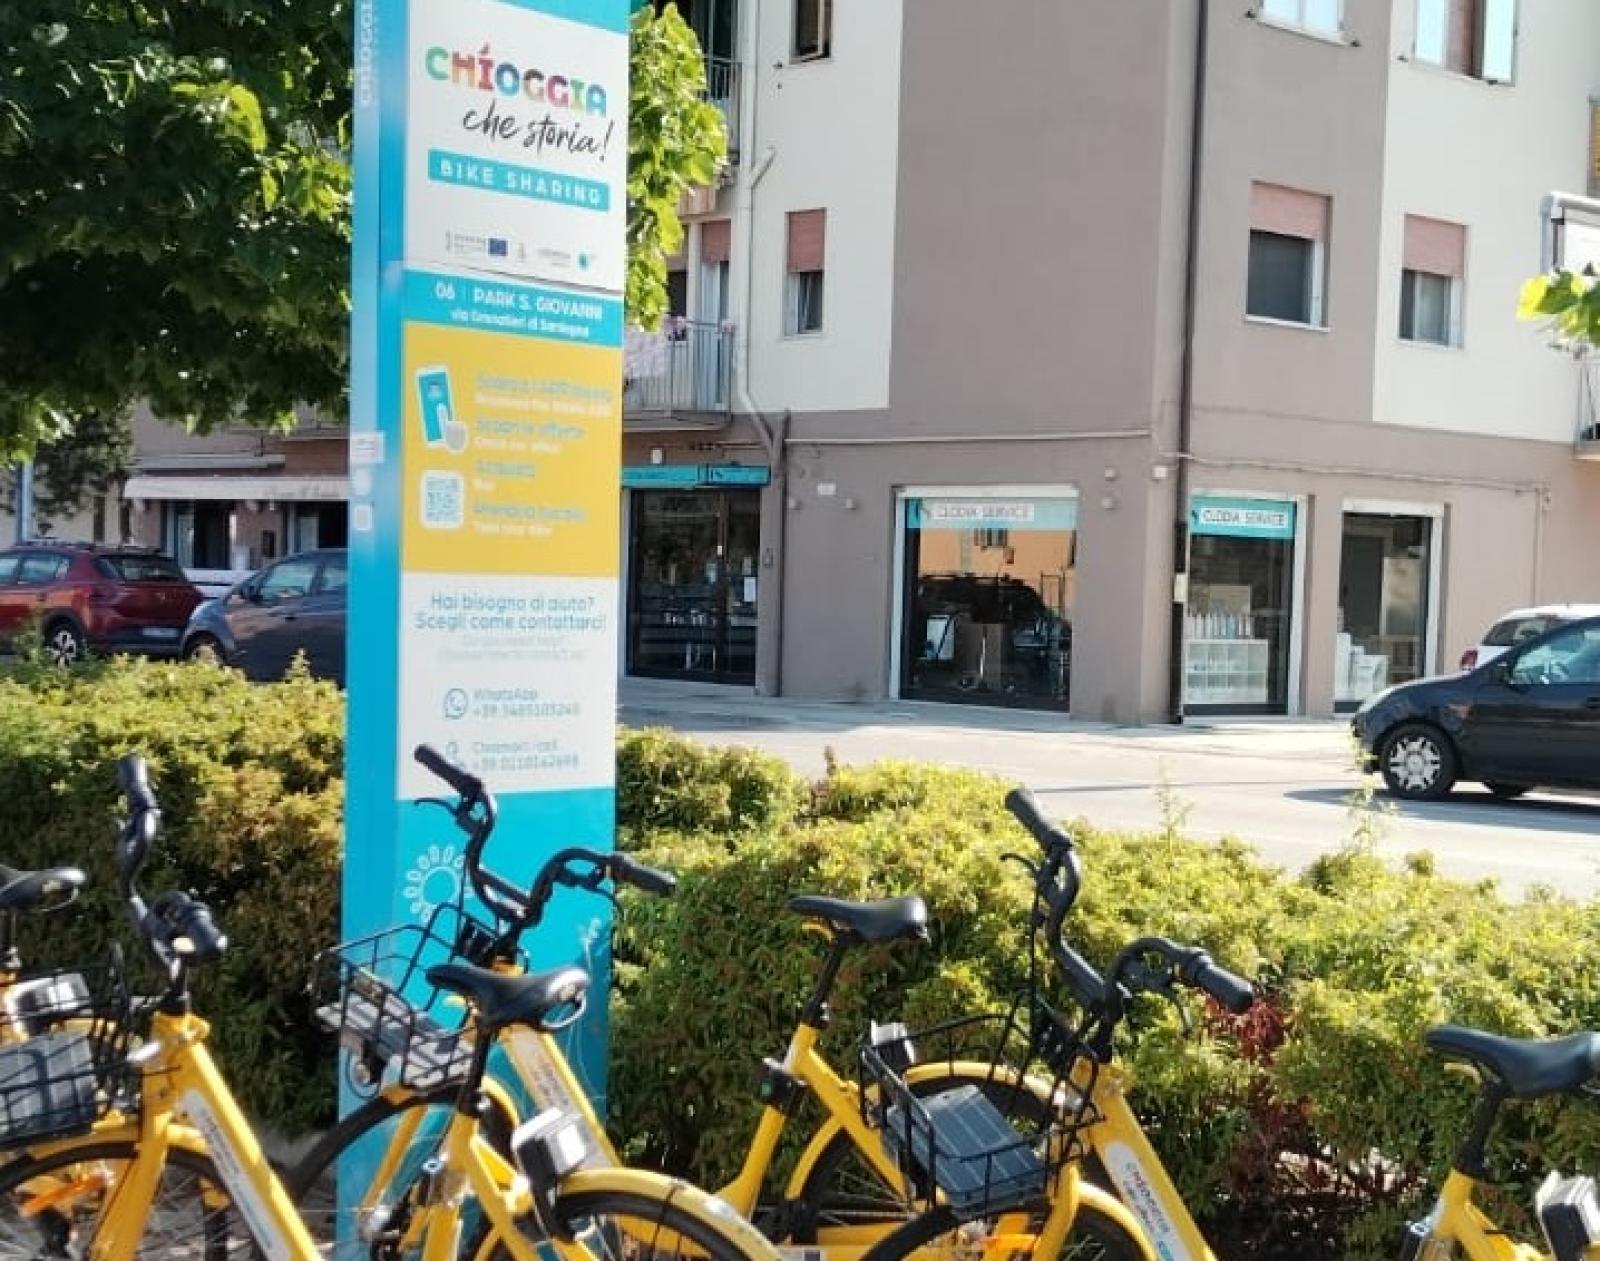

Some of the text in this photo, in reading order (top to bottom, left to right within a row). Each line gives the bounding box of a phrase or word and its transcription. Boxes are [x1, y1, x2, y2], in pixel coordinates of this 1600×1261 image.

[463, 99, 614, 162] che storia!
[440, 159, 601, 205] BIKE SHARING
[435, 281, 455, 300] 06
[473, 287, 514, 307] PARK
[516, 291, 530, 310] S.
[1245, 511, 1285, 527] SERVICE
[431, 593, 595, 615] Hai bisogno di aiuto?
[415, 612, 606, 631] Scegli come contattarci!
